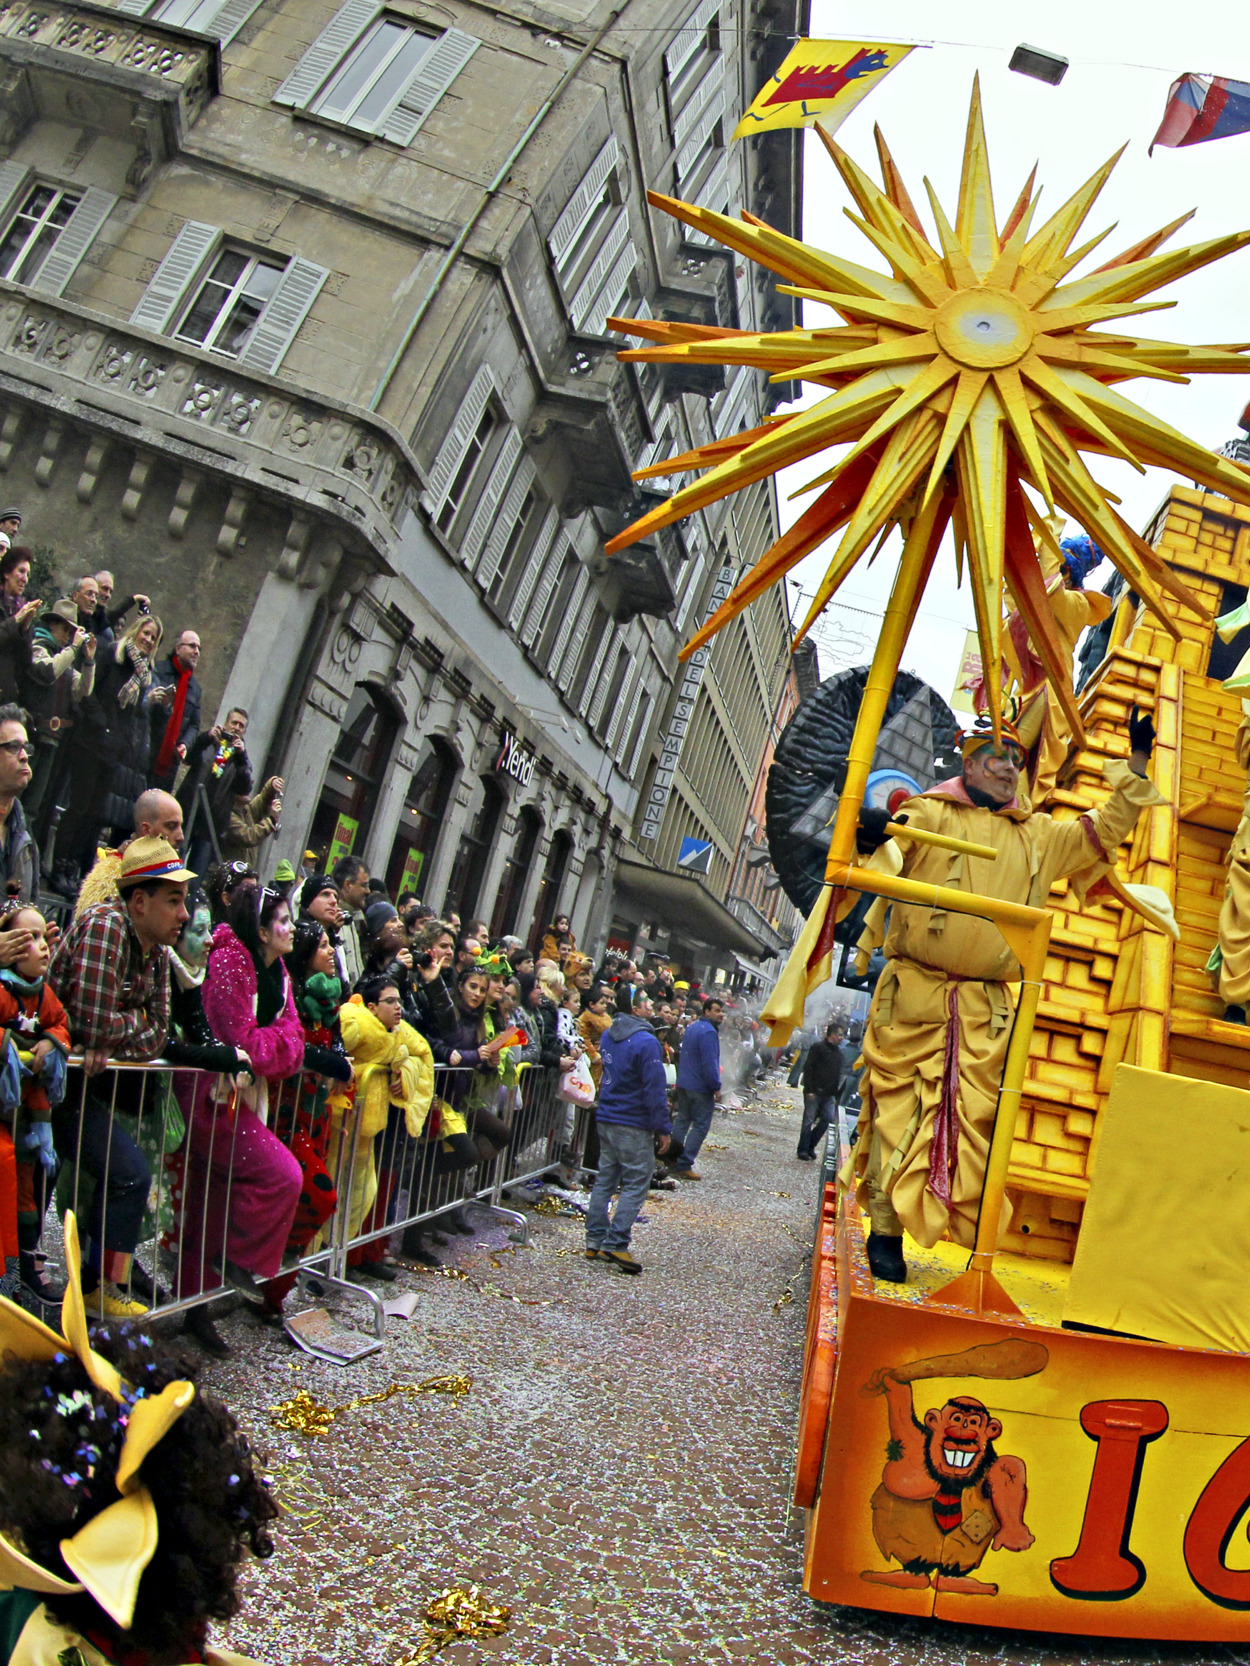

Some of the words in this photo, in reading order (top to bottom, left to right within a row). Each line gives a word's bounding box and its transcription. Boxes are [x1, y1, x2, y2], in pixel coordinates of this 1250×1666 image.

[684, 651, 705, 695] DEL
[644, 704, 688, 837] SEMPIONE
[1049, 1398, 1170, 1602] I
